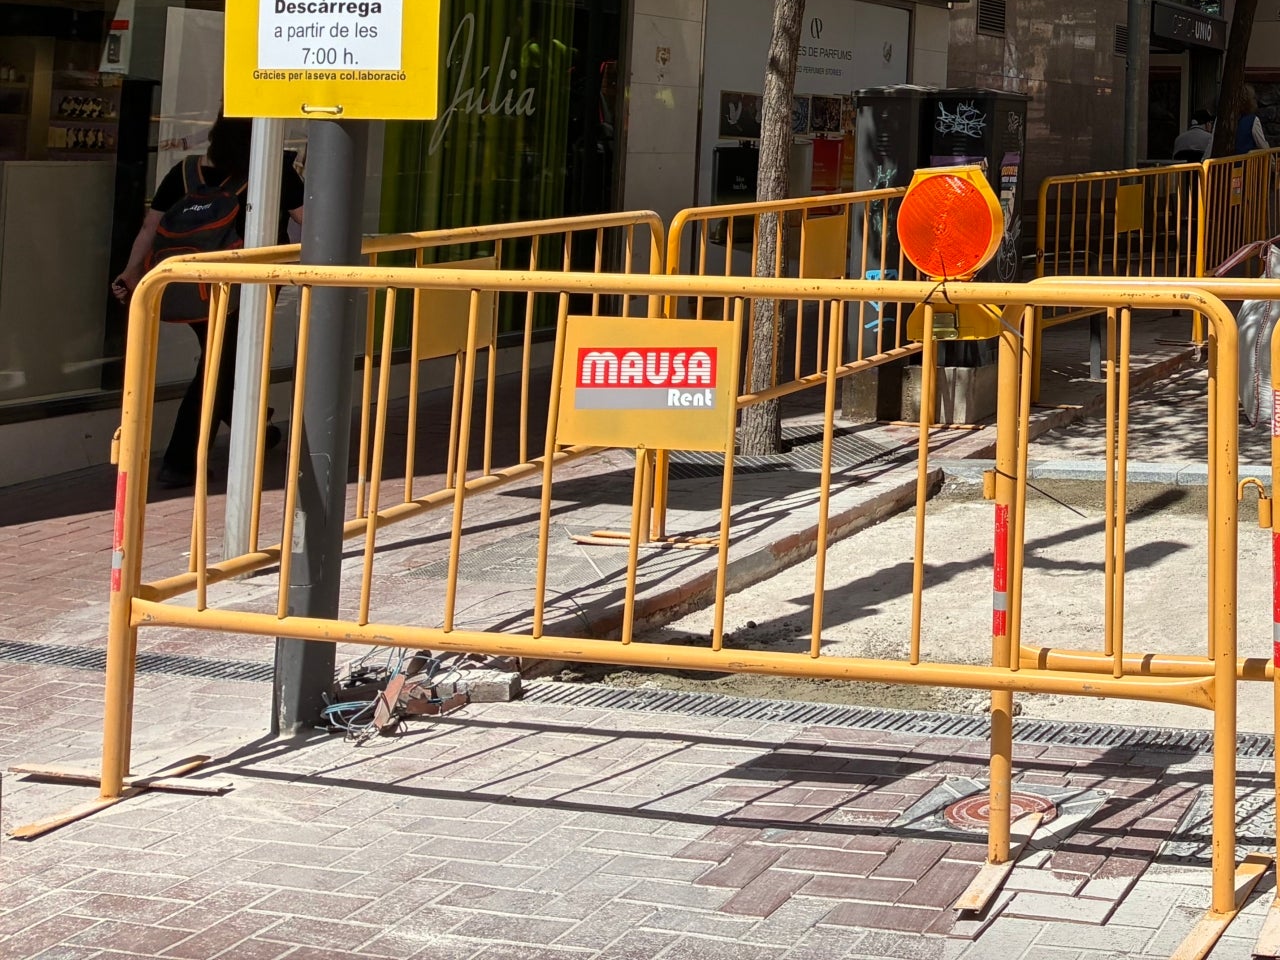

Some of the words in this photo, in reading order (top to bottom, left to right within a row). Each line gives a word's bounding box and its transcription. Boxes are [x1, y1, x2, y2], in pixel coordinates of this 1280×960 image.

[274, 25, 282, 38] a
[287, 22, 325, 42] partir
[329, 22, 349, 38] de
[355, 22, 378, 38] les
[302, 48, 337, 65] 7:00
[343, 48, 359, 65] h.
[808, 46, 818, 58] DE
[820, 47, 852, 61] PARFUMS
[253, 70, 286, 80] Gràcies
[288, 72, 302, 82] per
[339, 70, 406, 81] col.laboració
[428, 12, 536, 156] Júlia
[581, 351, 712, 385] MAUSA
[667, 388, 713, 407] Rent
